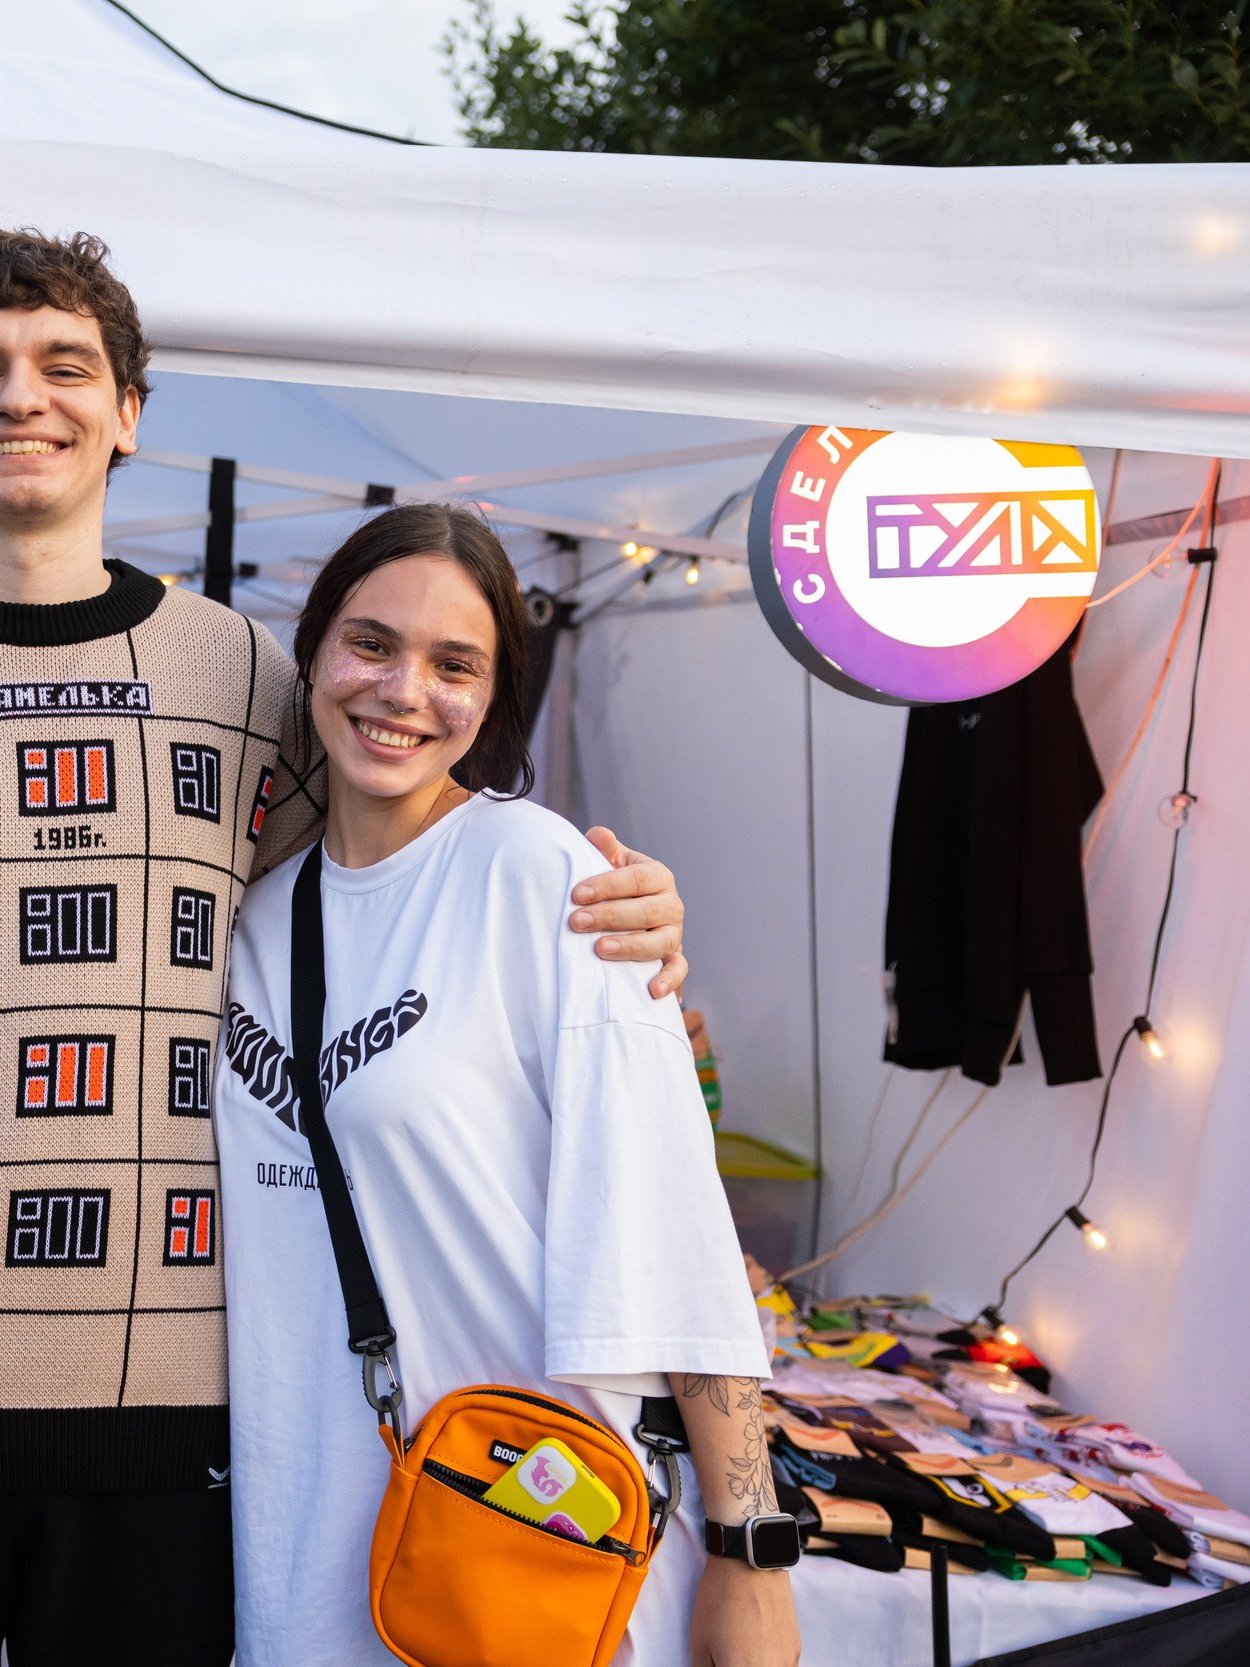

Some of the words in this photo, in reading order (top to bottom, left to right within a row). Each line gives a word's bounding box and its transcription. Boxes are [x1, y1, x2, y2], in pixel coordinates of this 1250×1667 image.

[782, 425, 855, 604] СДЕЛ
[34, 825, 107, 850] 1986г.
[257, 1162, 320, 1191] ОДЕЖД
